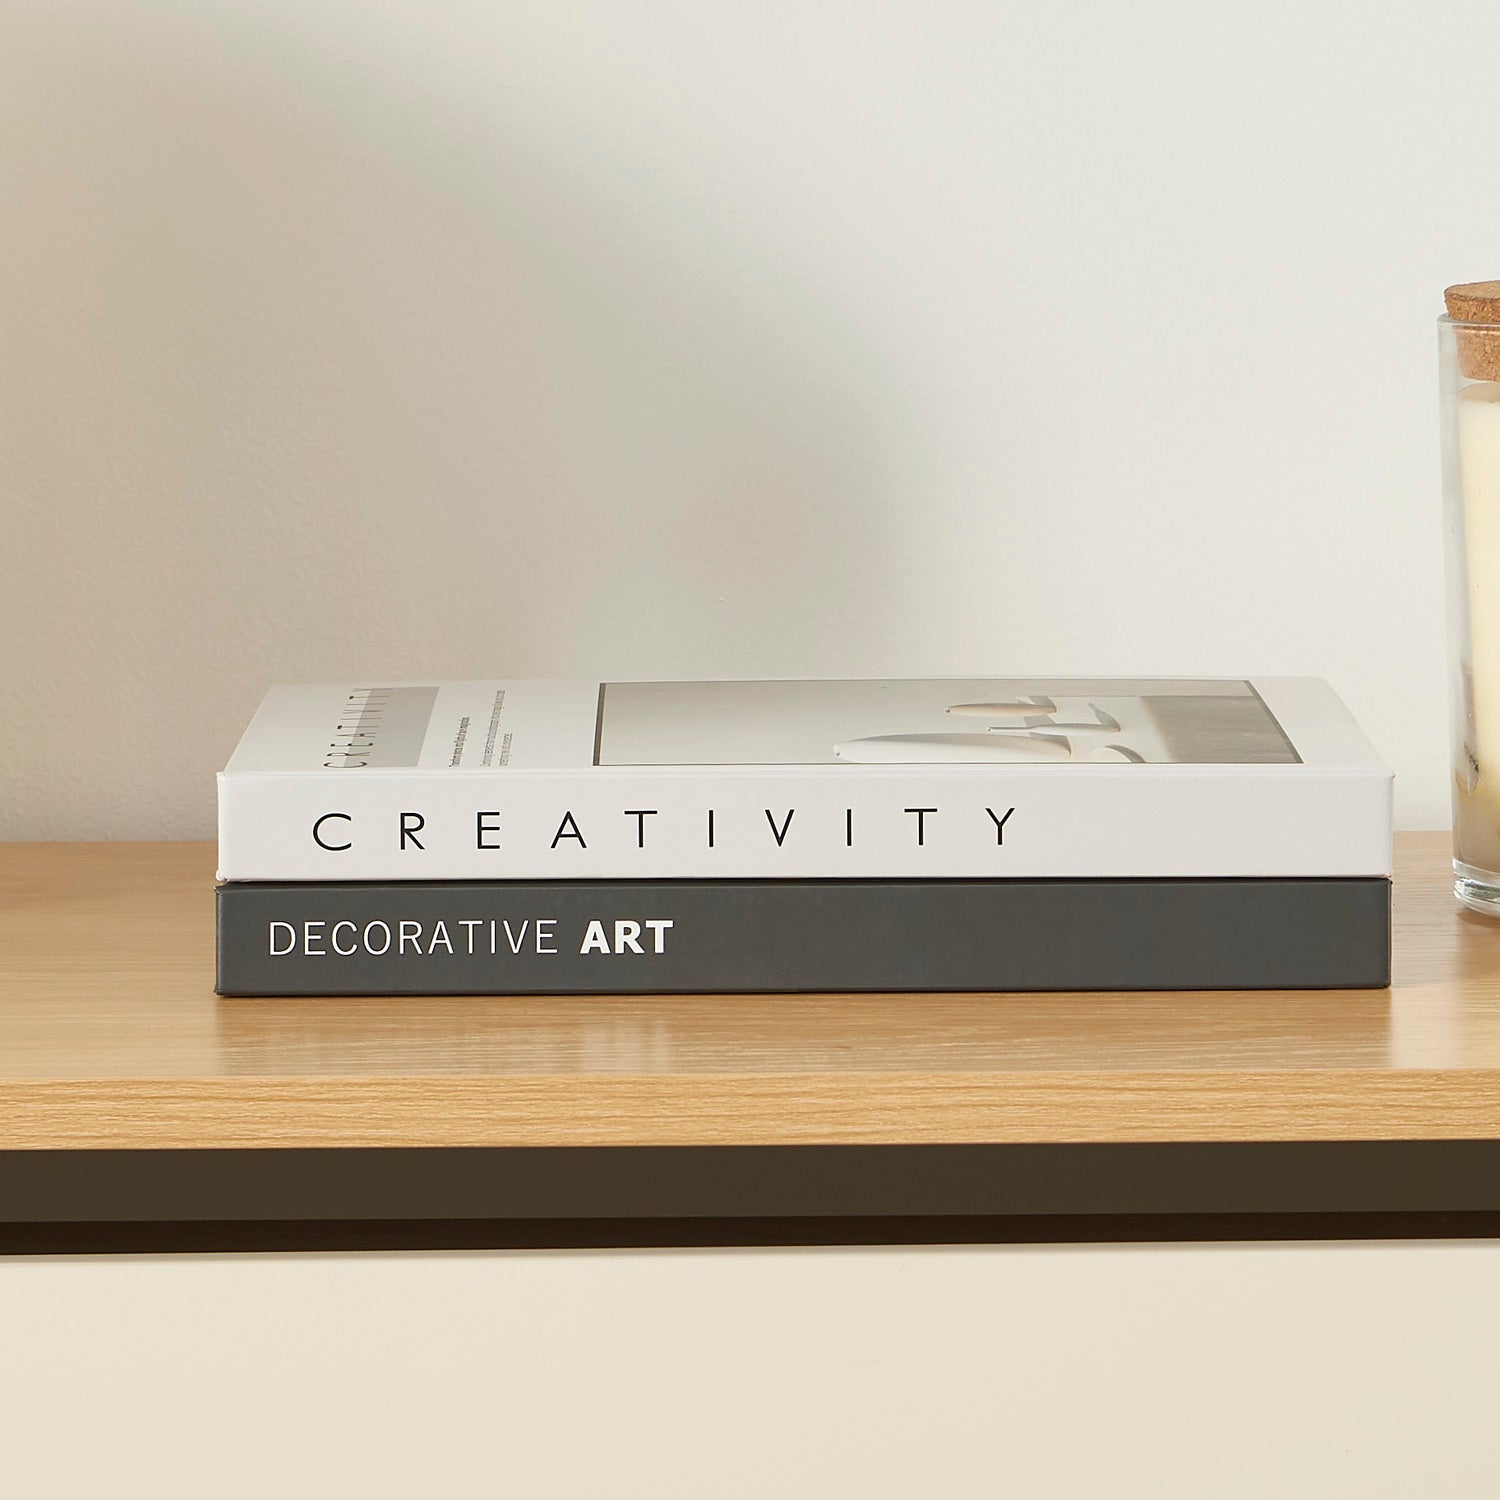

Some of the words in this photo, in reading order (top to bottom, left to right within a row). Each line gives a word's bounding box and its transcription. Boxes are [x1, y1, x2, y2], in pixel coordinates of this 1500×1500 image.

[323, 687, 393, 769] CREATIVITY
[313, 808, 1015, 851] CREATIVITY
[270, 920, 557, 955] DECORATIVE
[580, 920, 673, 953] ART
